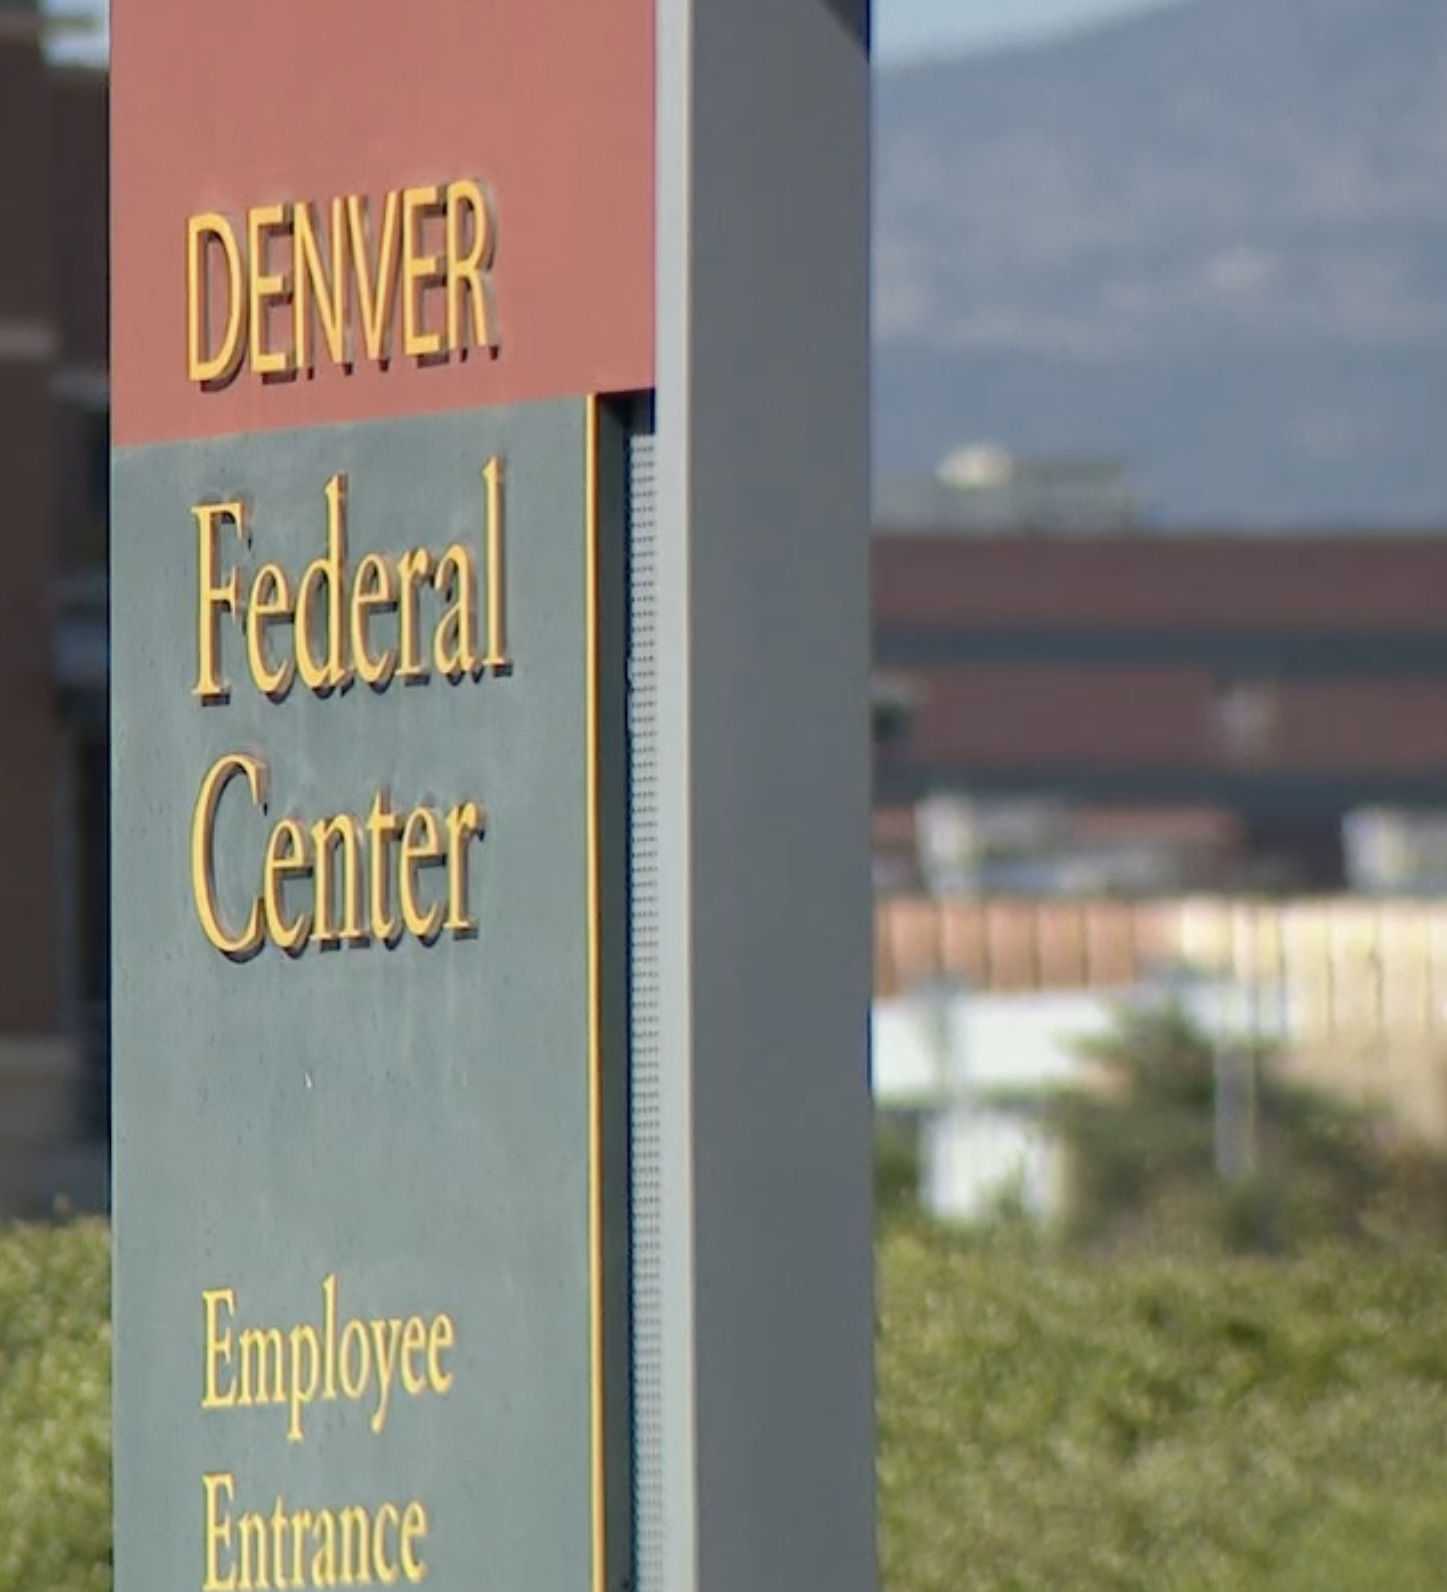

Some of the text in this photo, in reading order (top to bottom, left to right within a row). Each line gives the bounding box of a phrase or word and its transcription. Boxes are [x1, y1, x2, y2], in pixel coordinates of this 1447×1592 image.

[186, 178, 493, 383] DENVER
[190, 455, 509, 698] Federal
[190, 752, 487, 955] Center
[201, 1273, 455, 1442] Employee
[201, 1472, 429, 1592] Entrance
